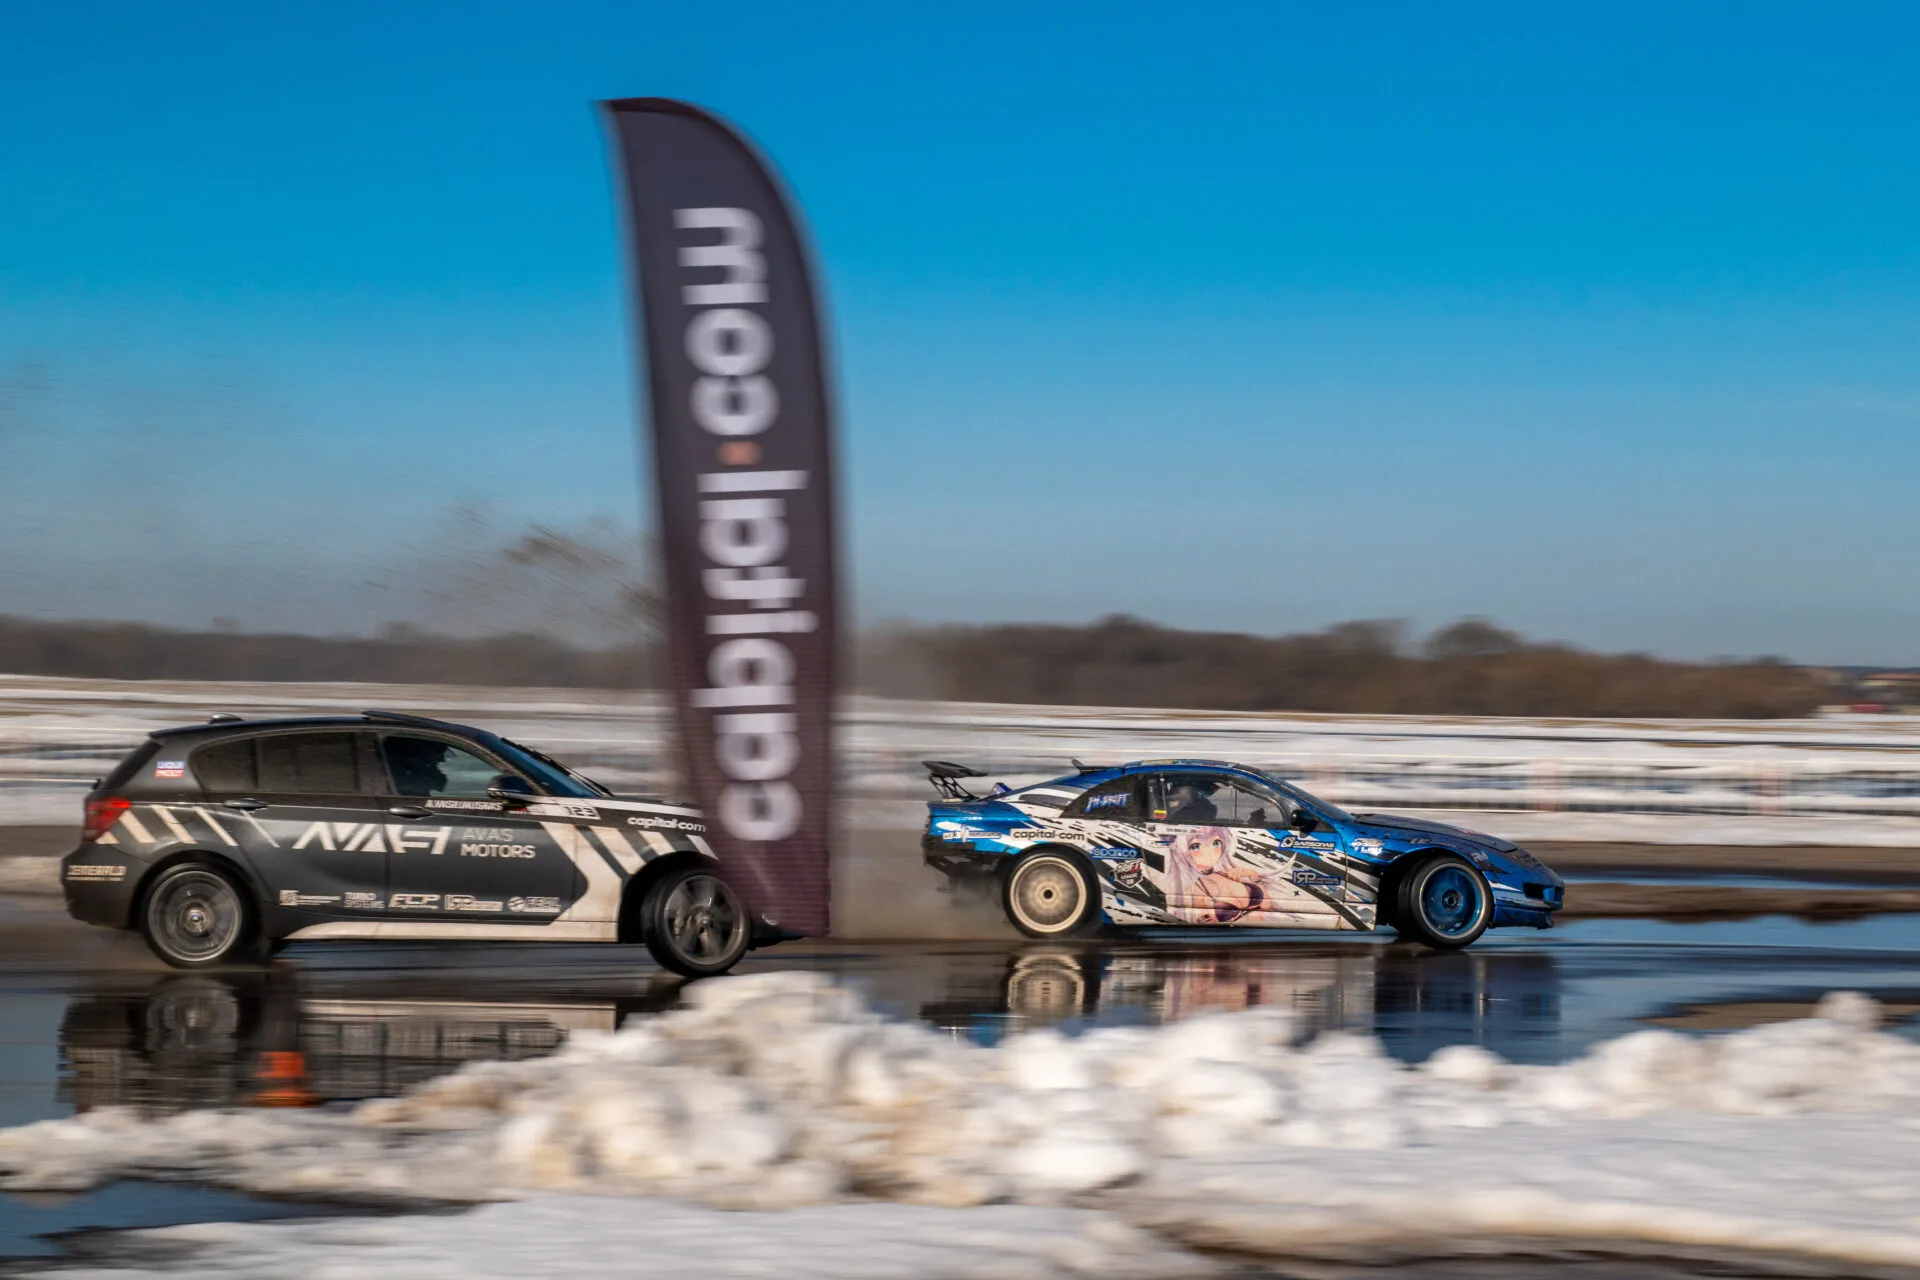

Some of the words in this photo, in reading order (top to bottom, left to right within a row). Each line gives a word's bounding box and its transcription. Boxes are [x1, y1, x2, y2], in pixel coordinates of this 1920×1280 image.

[672, 206, 818, 842] capital.com
[564, 805, 598, 818] 123
[626, 816, 707, 833] capital.com
[462, 827, 515, 843] AVAS
[1012, 829, 1086, 842] capital.com
[460, 843, 537, 860] MOTORS
